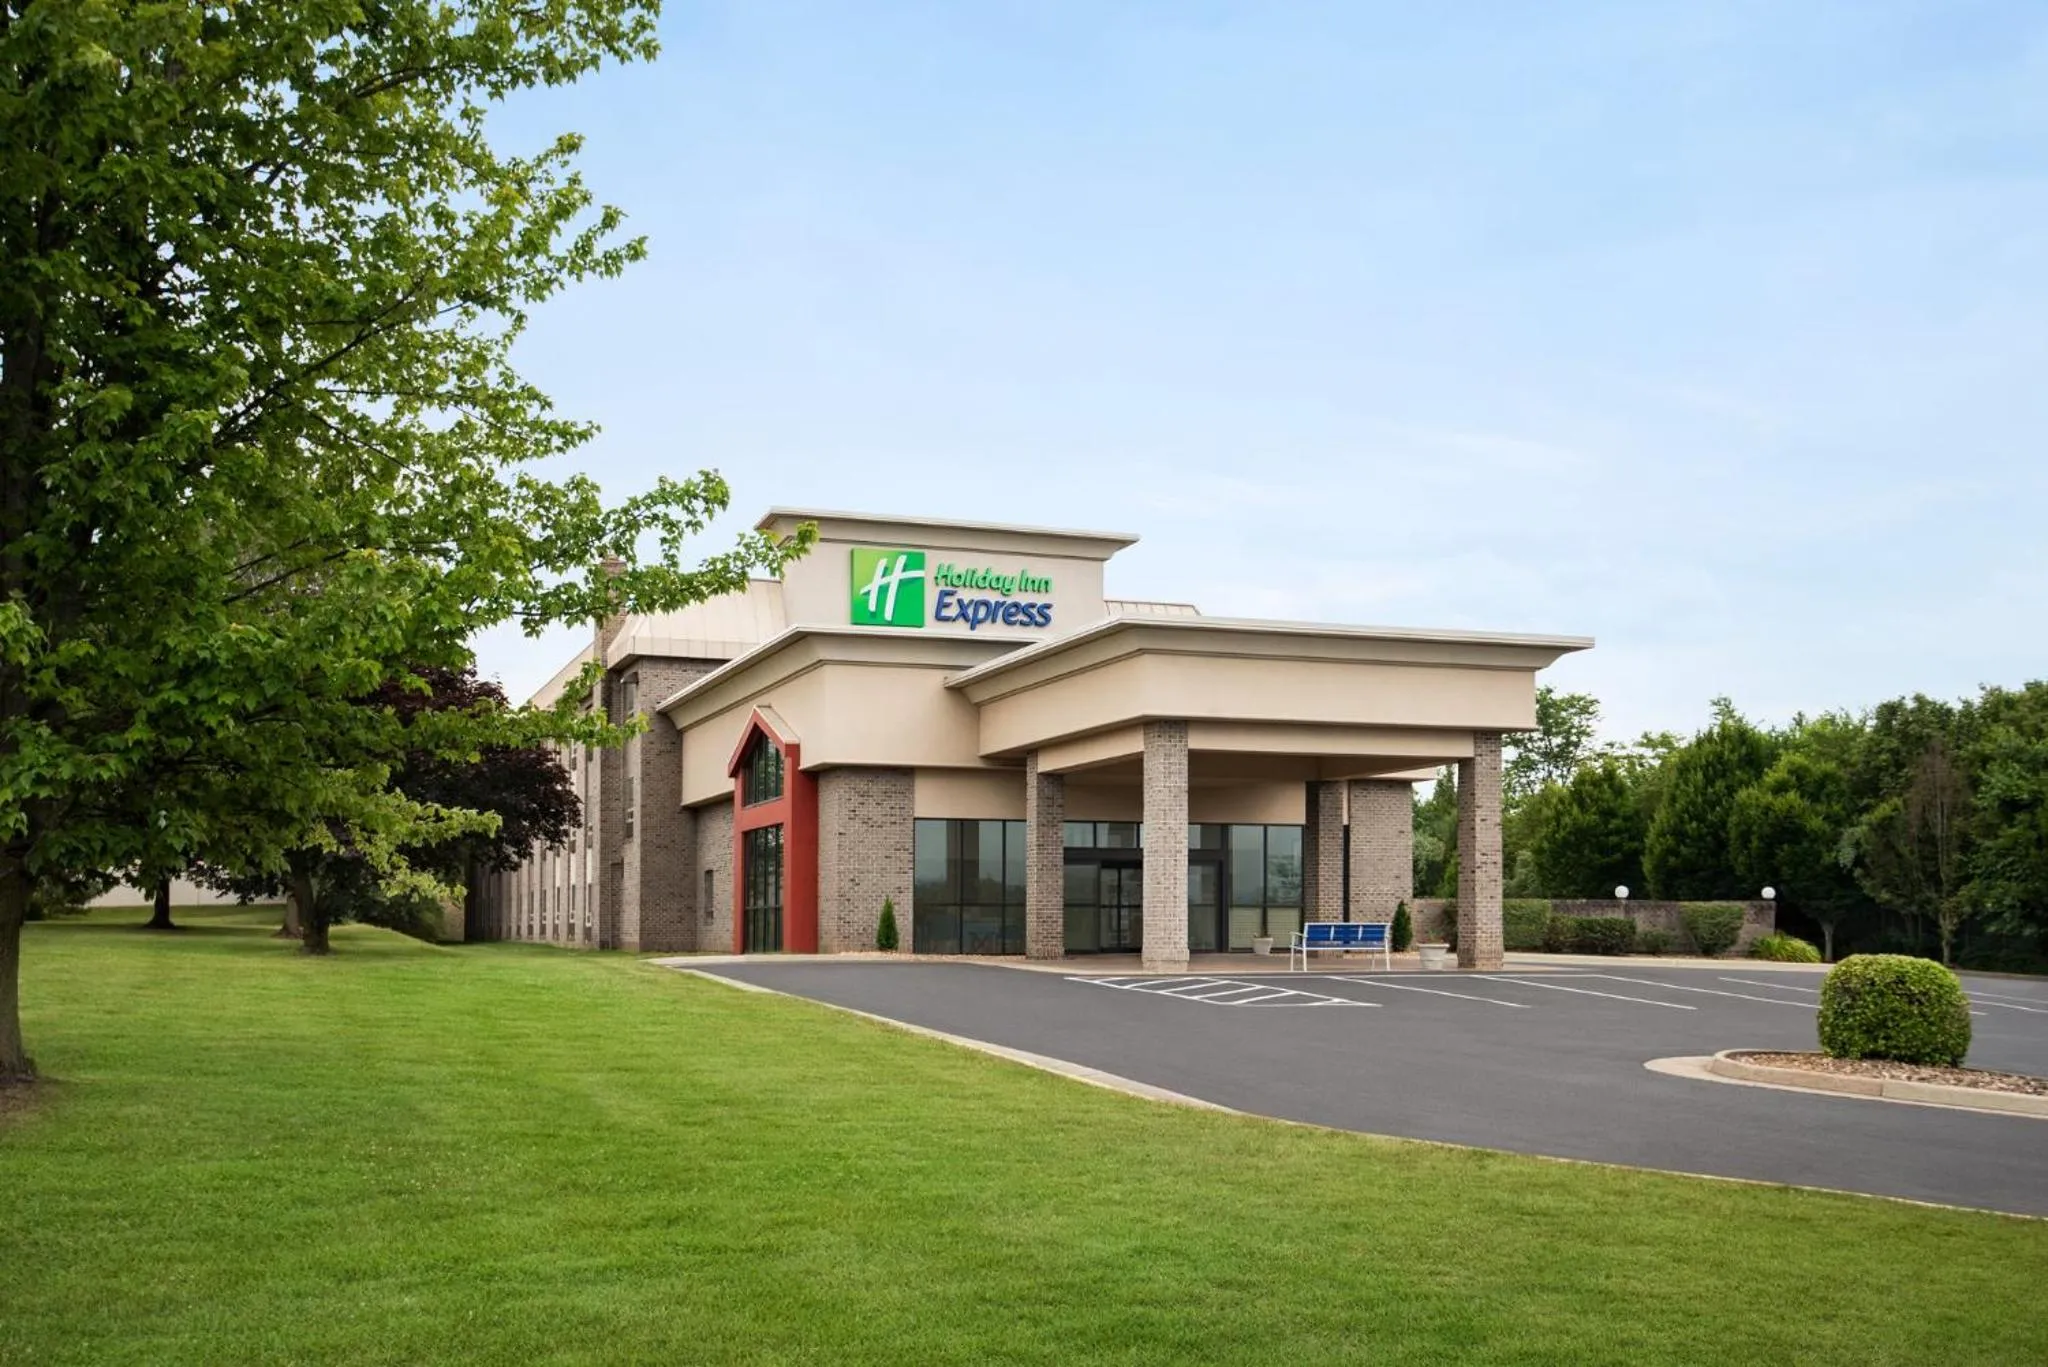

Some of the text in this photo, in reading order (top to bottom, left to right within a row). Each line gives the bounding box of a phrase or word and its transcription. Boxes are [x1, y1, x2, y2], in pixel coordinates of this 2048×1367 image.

[934, 563, 1052, 596] Holiday Inn
[934, 589, 1053, 630] Express
